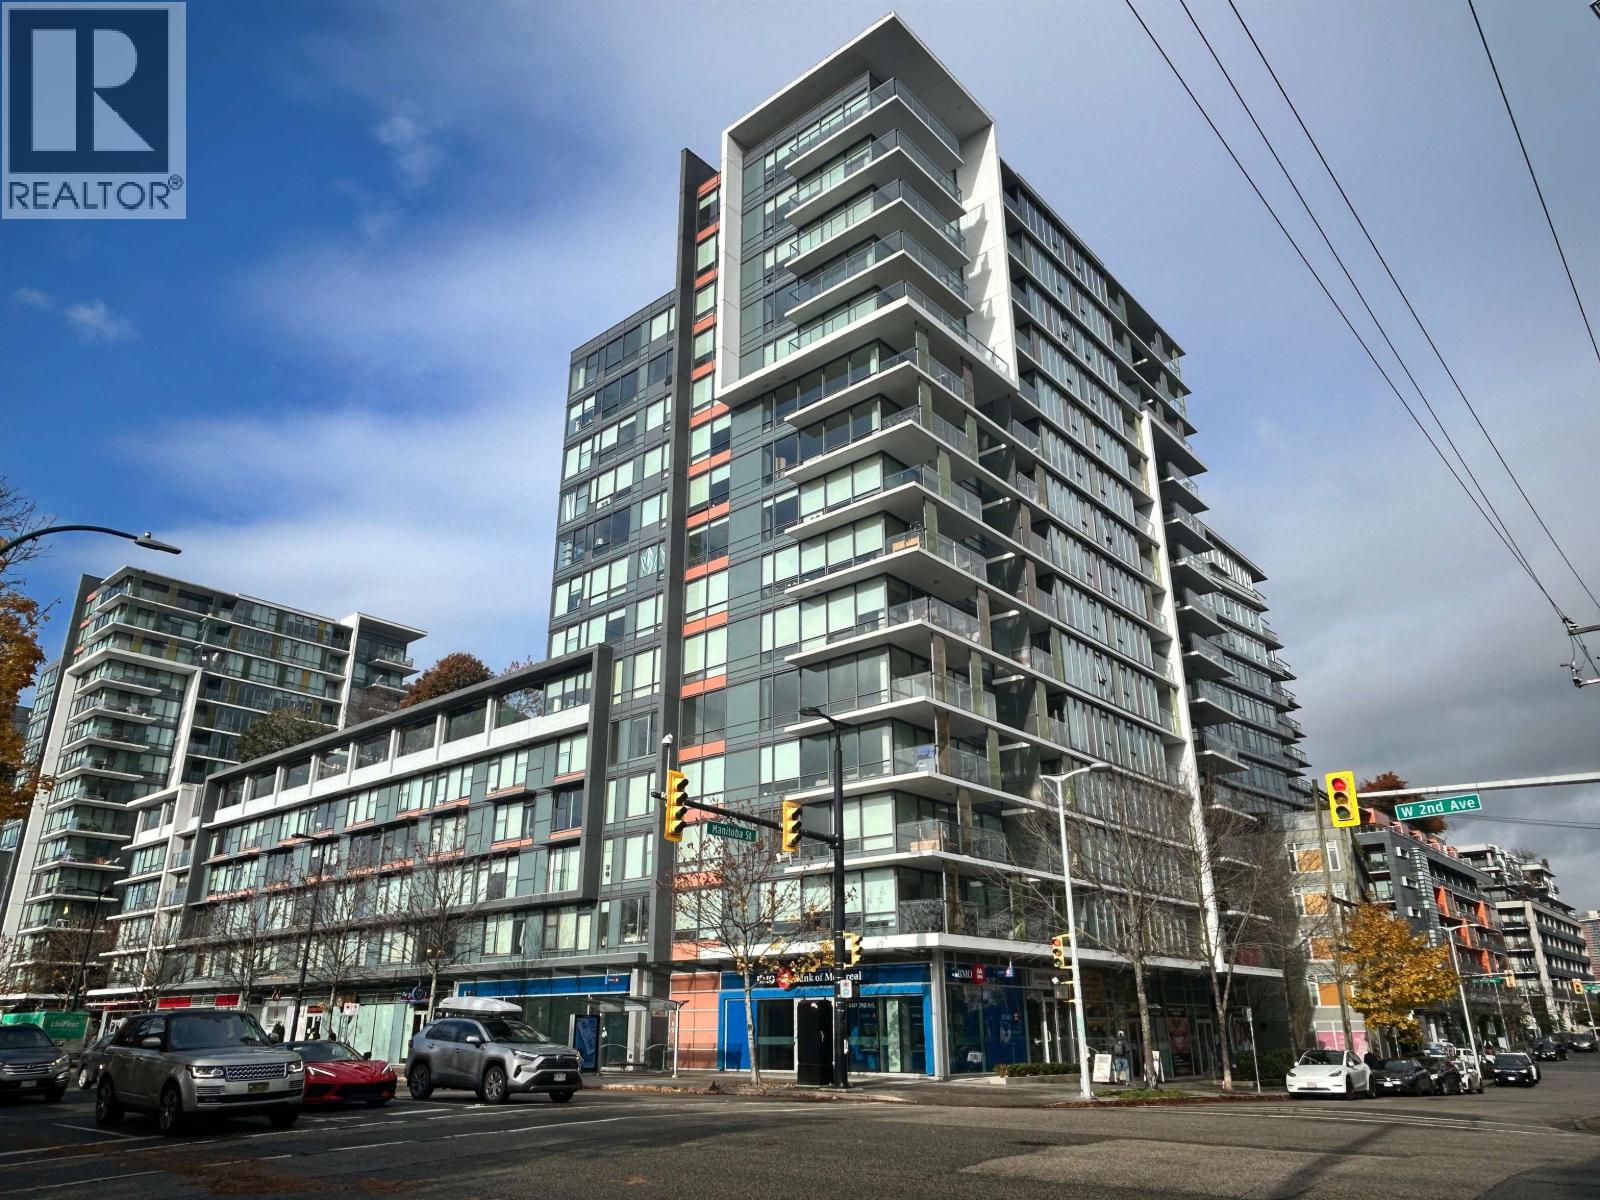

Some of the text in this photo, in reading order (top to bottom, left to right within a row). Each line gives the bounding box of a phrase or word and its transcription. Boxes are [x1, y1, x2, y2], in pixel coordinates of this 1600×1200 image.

[1401, 799, 1475, 817] W 2nd Ave
[712, 824, 752, 840] Manitoba St
[816, 973, 824, 981] of
[825, 971, 862, 981] Mreal
